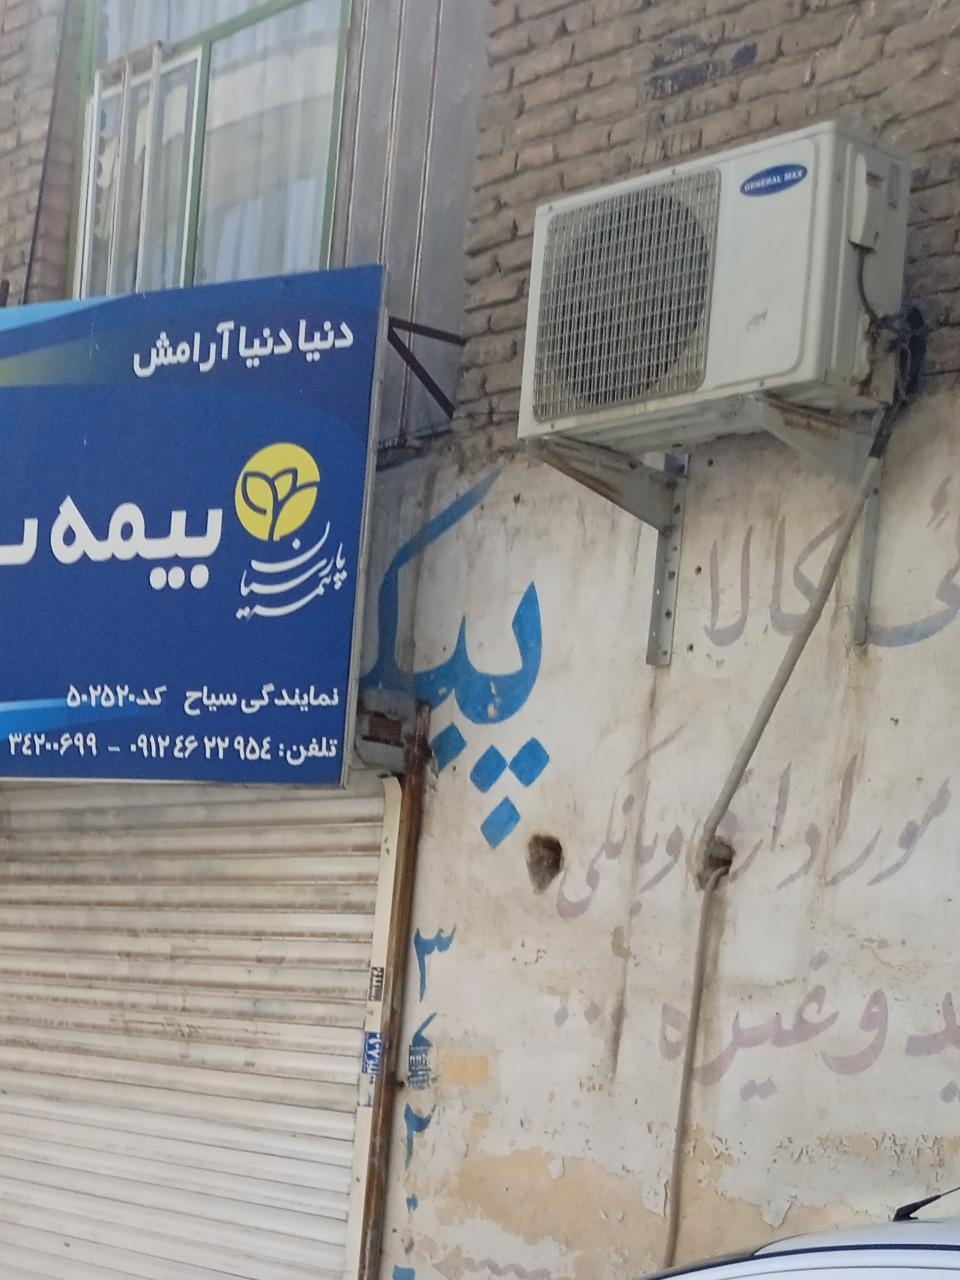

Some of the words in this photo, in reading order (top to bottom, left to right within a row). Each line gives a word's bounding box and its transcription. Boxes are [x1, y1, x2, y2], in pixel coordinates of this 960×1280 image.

[133, 320, 235, 378] آرامش
[239, 325, 292, 368] دنیا
[298, 319, 354, 362] دنیا
[50, 494, 224, 590] بیمه
[183, 685, 238, 716] سیاح
[241, 682, 339, 714] نمایندگی
[278, 736, 338, 766] تلفن:
